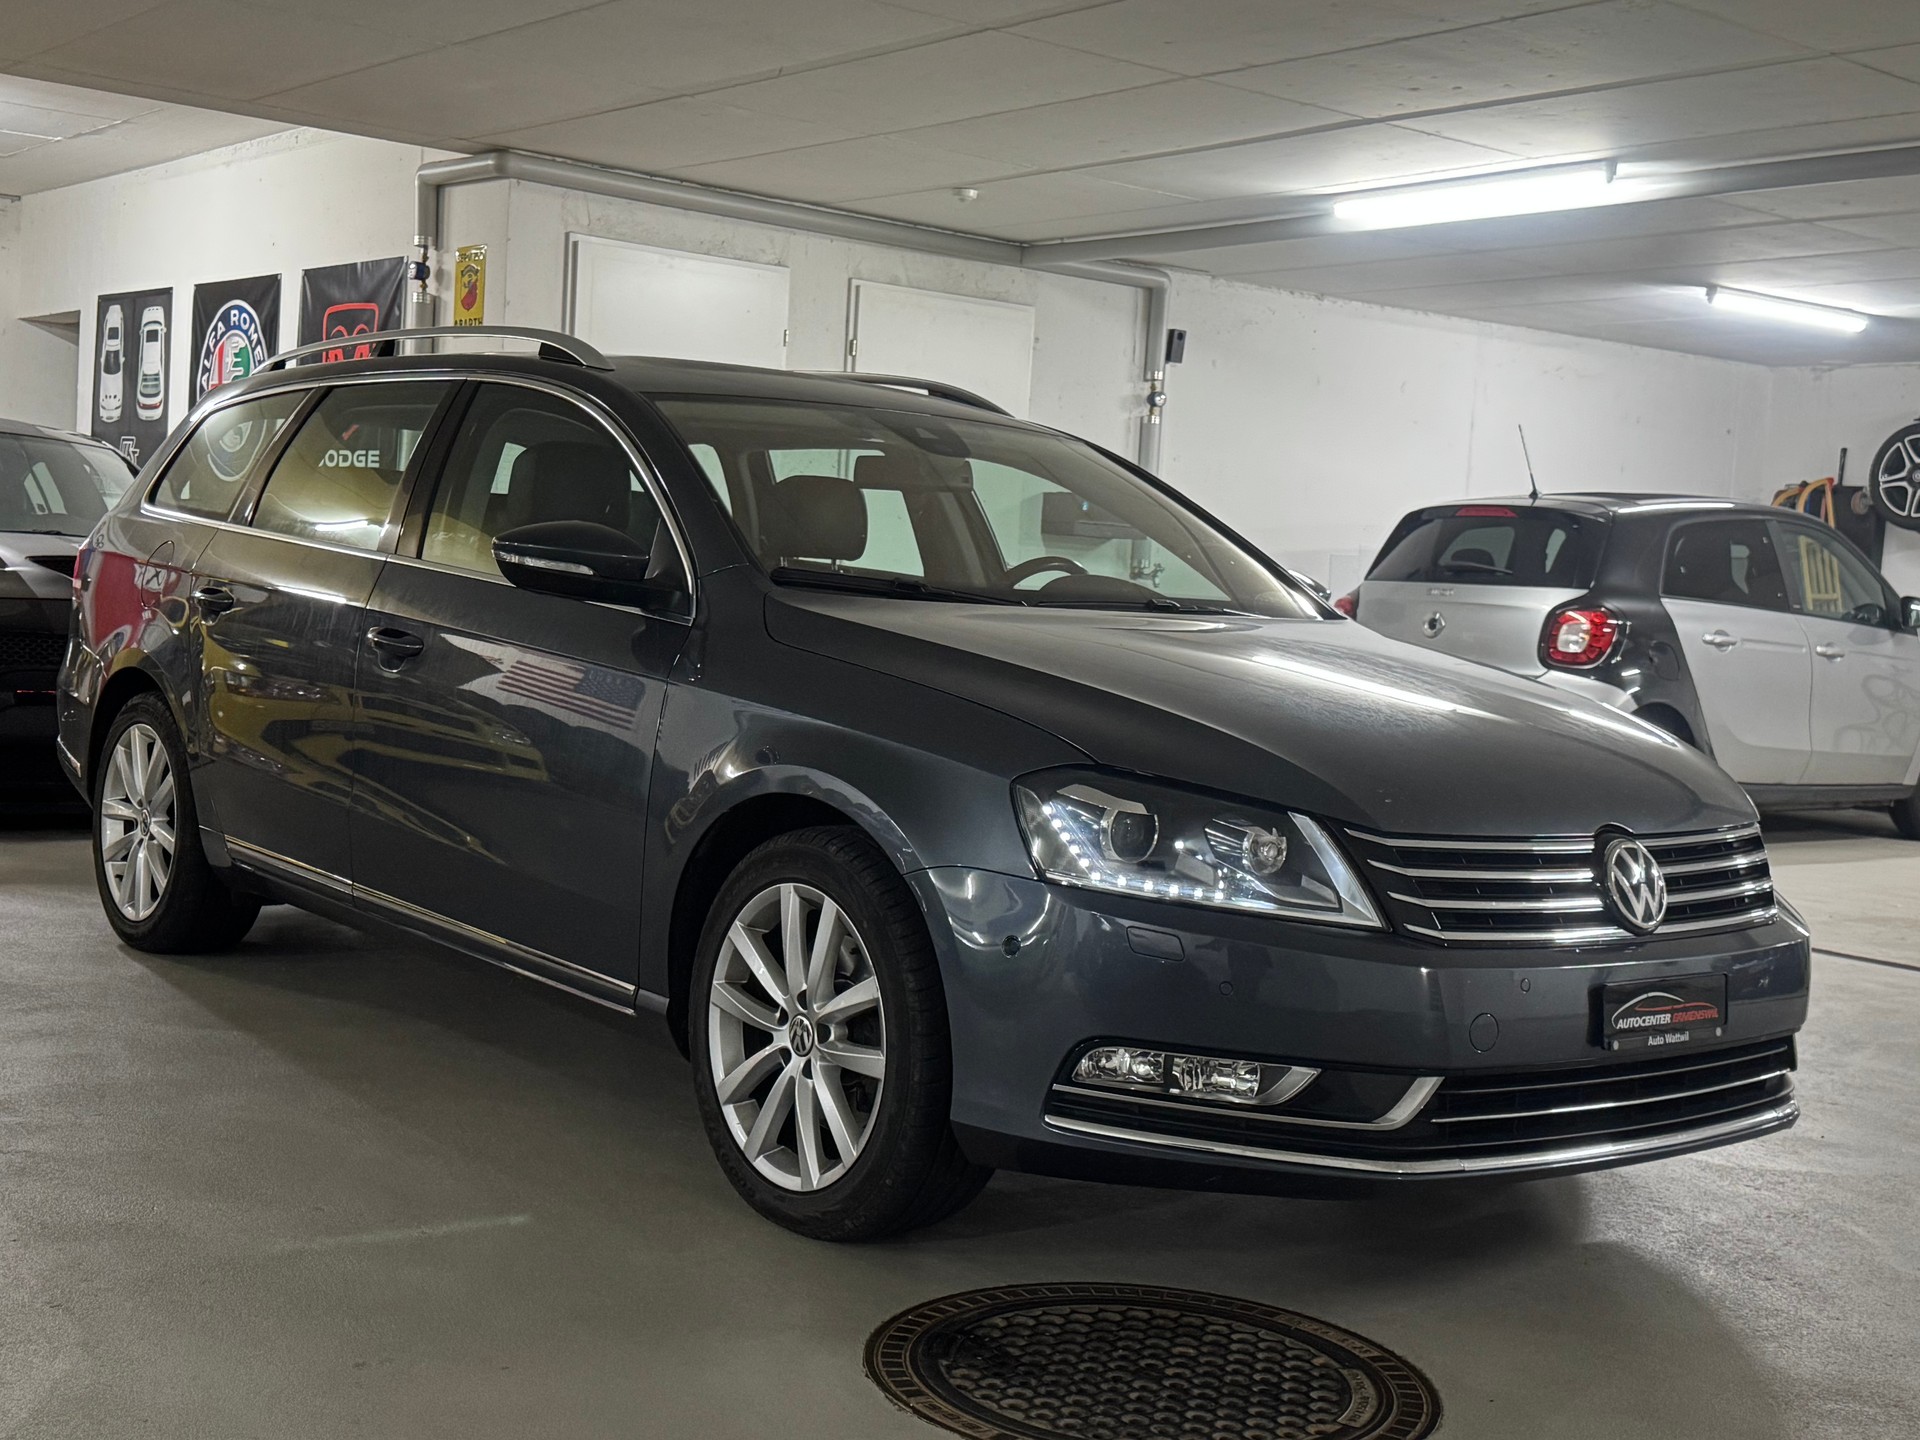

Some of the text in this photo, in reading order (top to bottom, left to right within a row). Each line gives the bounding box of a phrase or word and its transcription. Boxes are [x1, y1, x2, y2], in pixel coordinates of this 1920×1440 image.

[454, 316, 484, 327] ABARTH
[201, 309, 264, 391] ALFA ROME
[318, 449, 380, 469] ODGE
[1616, 1013, 1672, 1030] AUTOCENTER
[1648, 1030, 1690, 1047] Auto Wattwil
